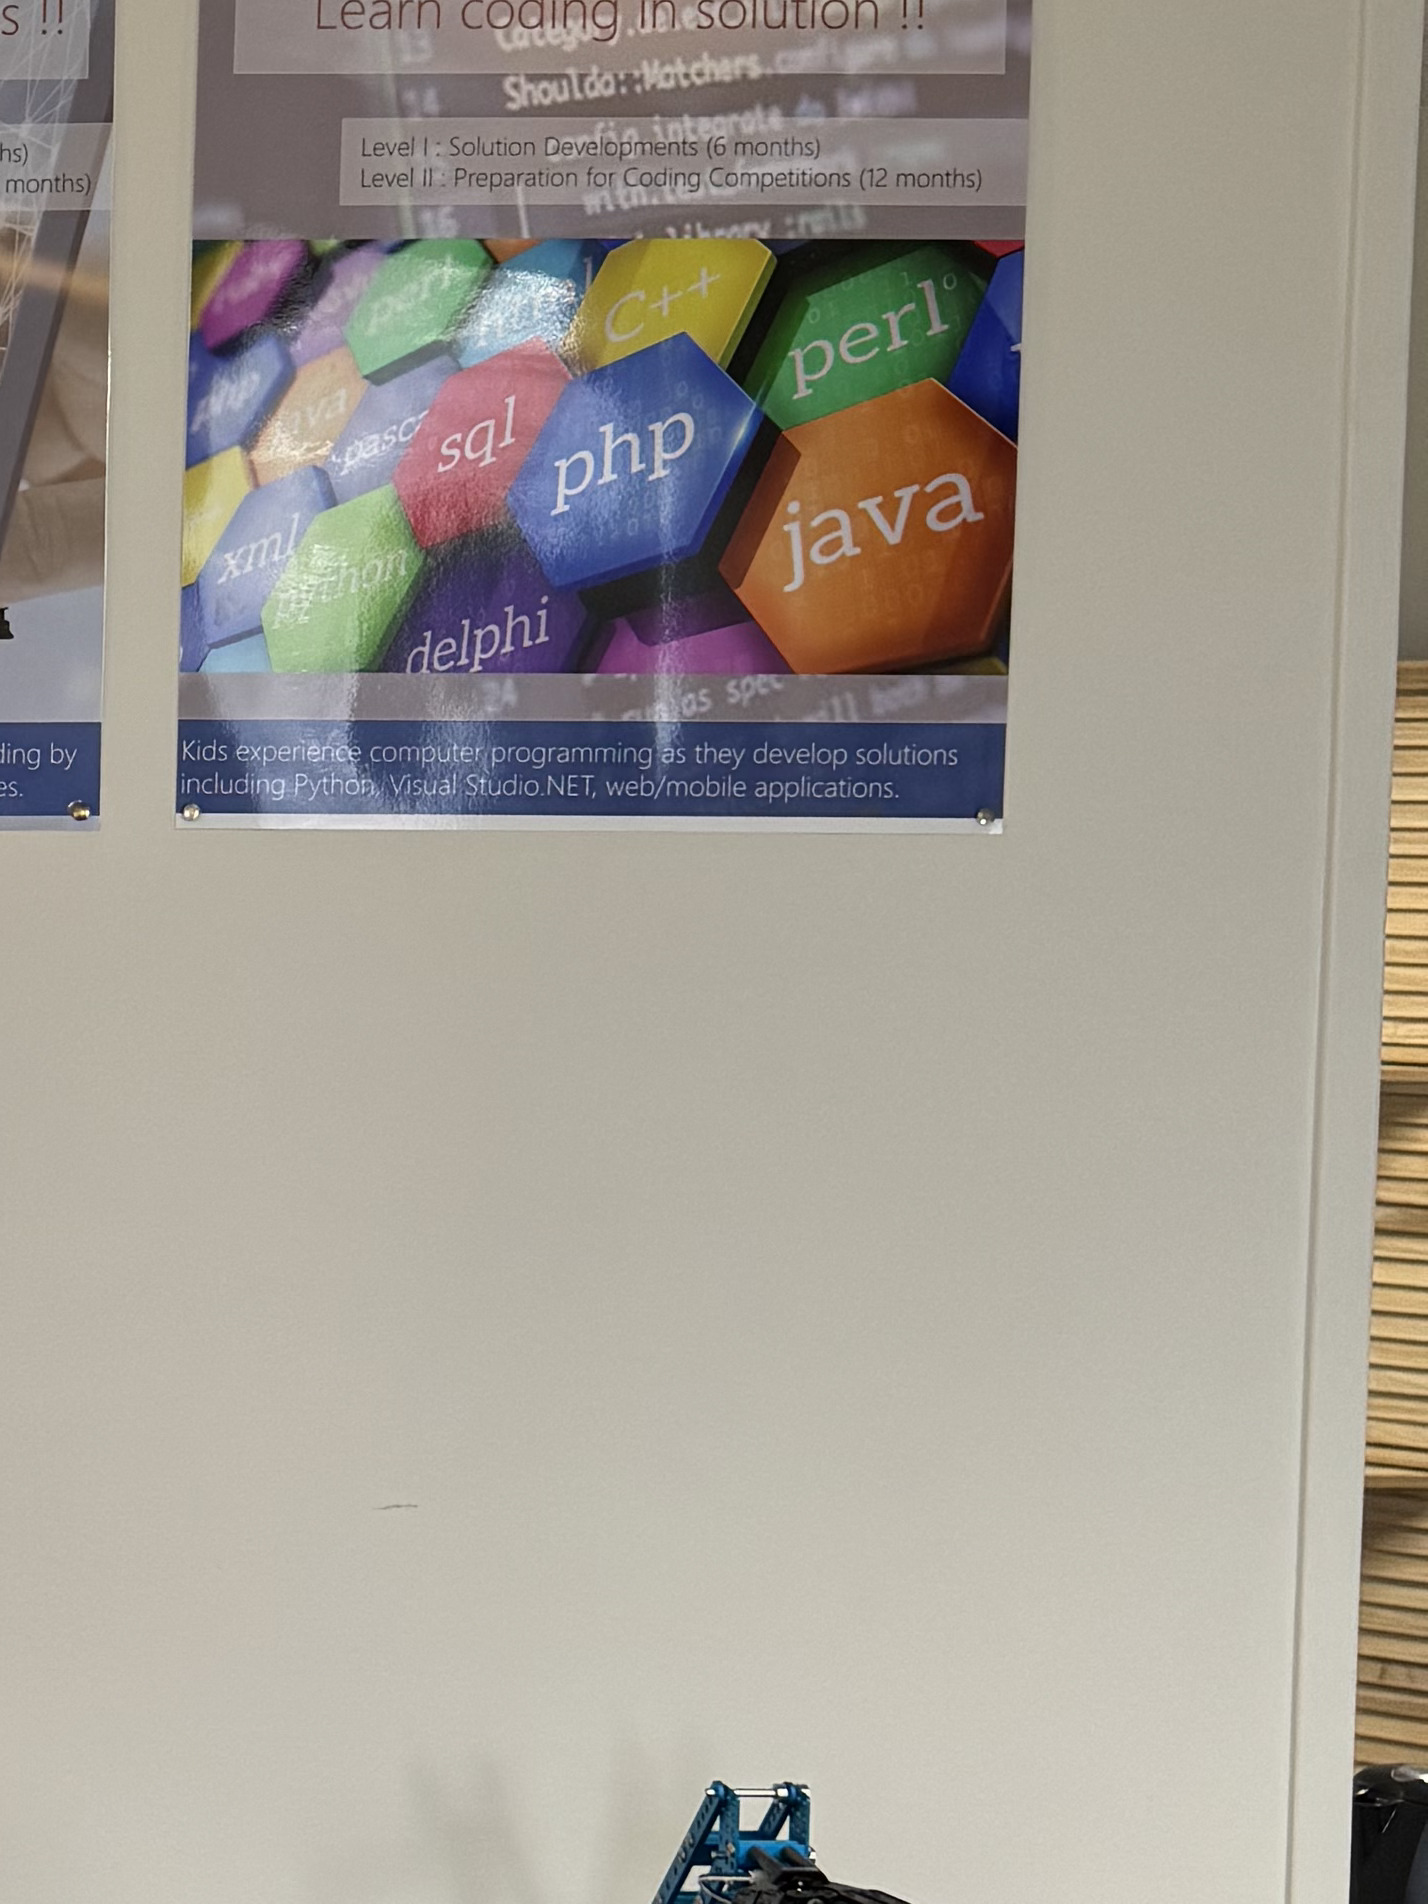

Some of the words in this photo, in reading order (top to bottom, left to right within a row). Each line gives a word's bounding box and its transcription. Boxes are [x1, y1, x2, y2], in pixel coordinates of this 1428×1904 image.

[5, 173, 92, 197] months)
[604, 266, 722, 344] C++
[788, 279, 950, 400] perl
[437, 395, 517, 474] sql
[549, 408, 696, 517] php
[216, 512, 300, 586] xml
[780, 470, 987, 592] java
[406, 595, 550, 674] delphi
[50, 742, 78, 771] by
[181, 772, 286, 801] including
[294, 772, 381, 801] Python,
[389, 772, 457, 797] Visual
[465, 773, 597, 799] Studio.NET,
[605, 774, 747, 800] web/mobile
[754, 775, 900, 803] applications.
